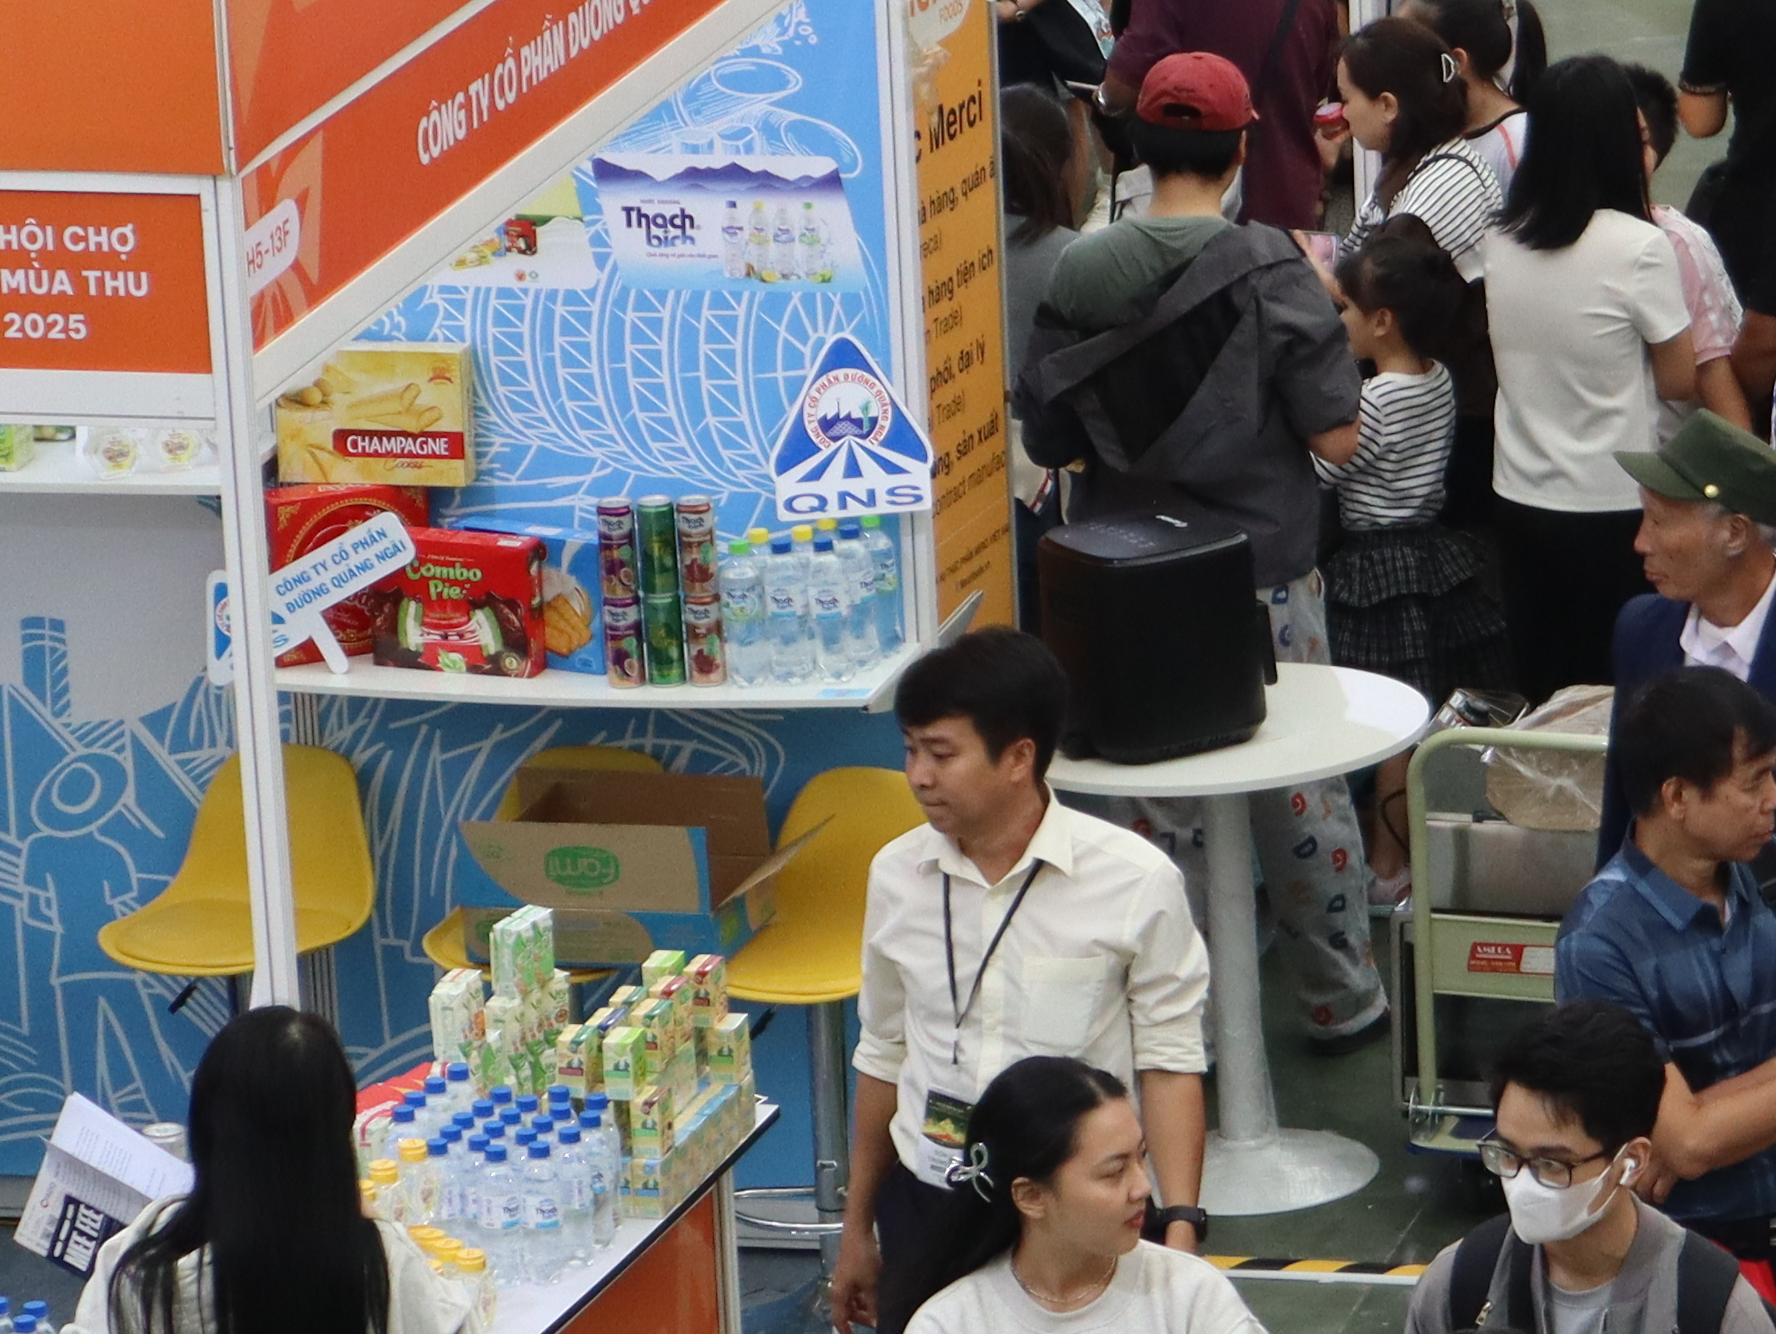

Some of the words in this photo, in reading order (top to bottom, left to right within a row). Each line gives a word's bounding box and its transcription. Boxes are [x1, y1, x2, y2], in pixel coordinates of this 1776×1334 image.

[417, 99, 465, 166] CÔNG
[468, 72, 490, 129] TY
[493, 36, 518, 111] CỔ
[929, 79, 984, 154] Merci
[0, 218, 54, 258] HỘI
[63, 223, 136, 261] CHỢ
[246, 217, 291, 278] H5-13F
[1, 261, 74, 296] MÙA
[81, 270, 149, 298] THU
[3, 312, 88, 341] 2025
[346, 435, 450, 456] CHAMPAGNE
[783, 484, 925, 515] QNS
[275, 568, 311, 598] CÔNG
[310, 560, 328, 580] TY
[331, 543, 350, 566] CỔ
[352, 526, 389, 555] PHẦN
[285, 580, 331, 615] ĐƯỜNG
[332, 561, 375, 590] QUẢNG
[376, 538, 408, 568] NGÃI
[405, 559, 483, 581] Combo
[428, 579, 465, 601] Pie
